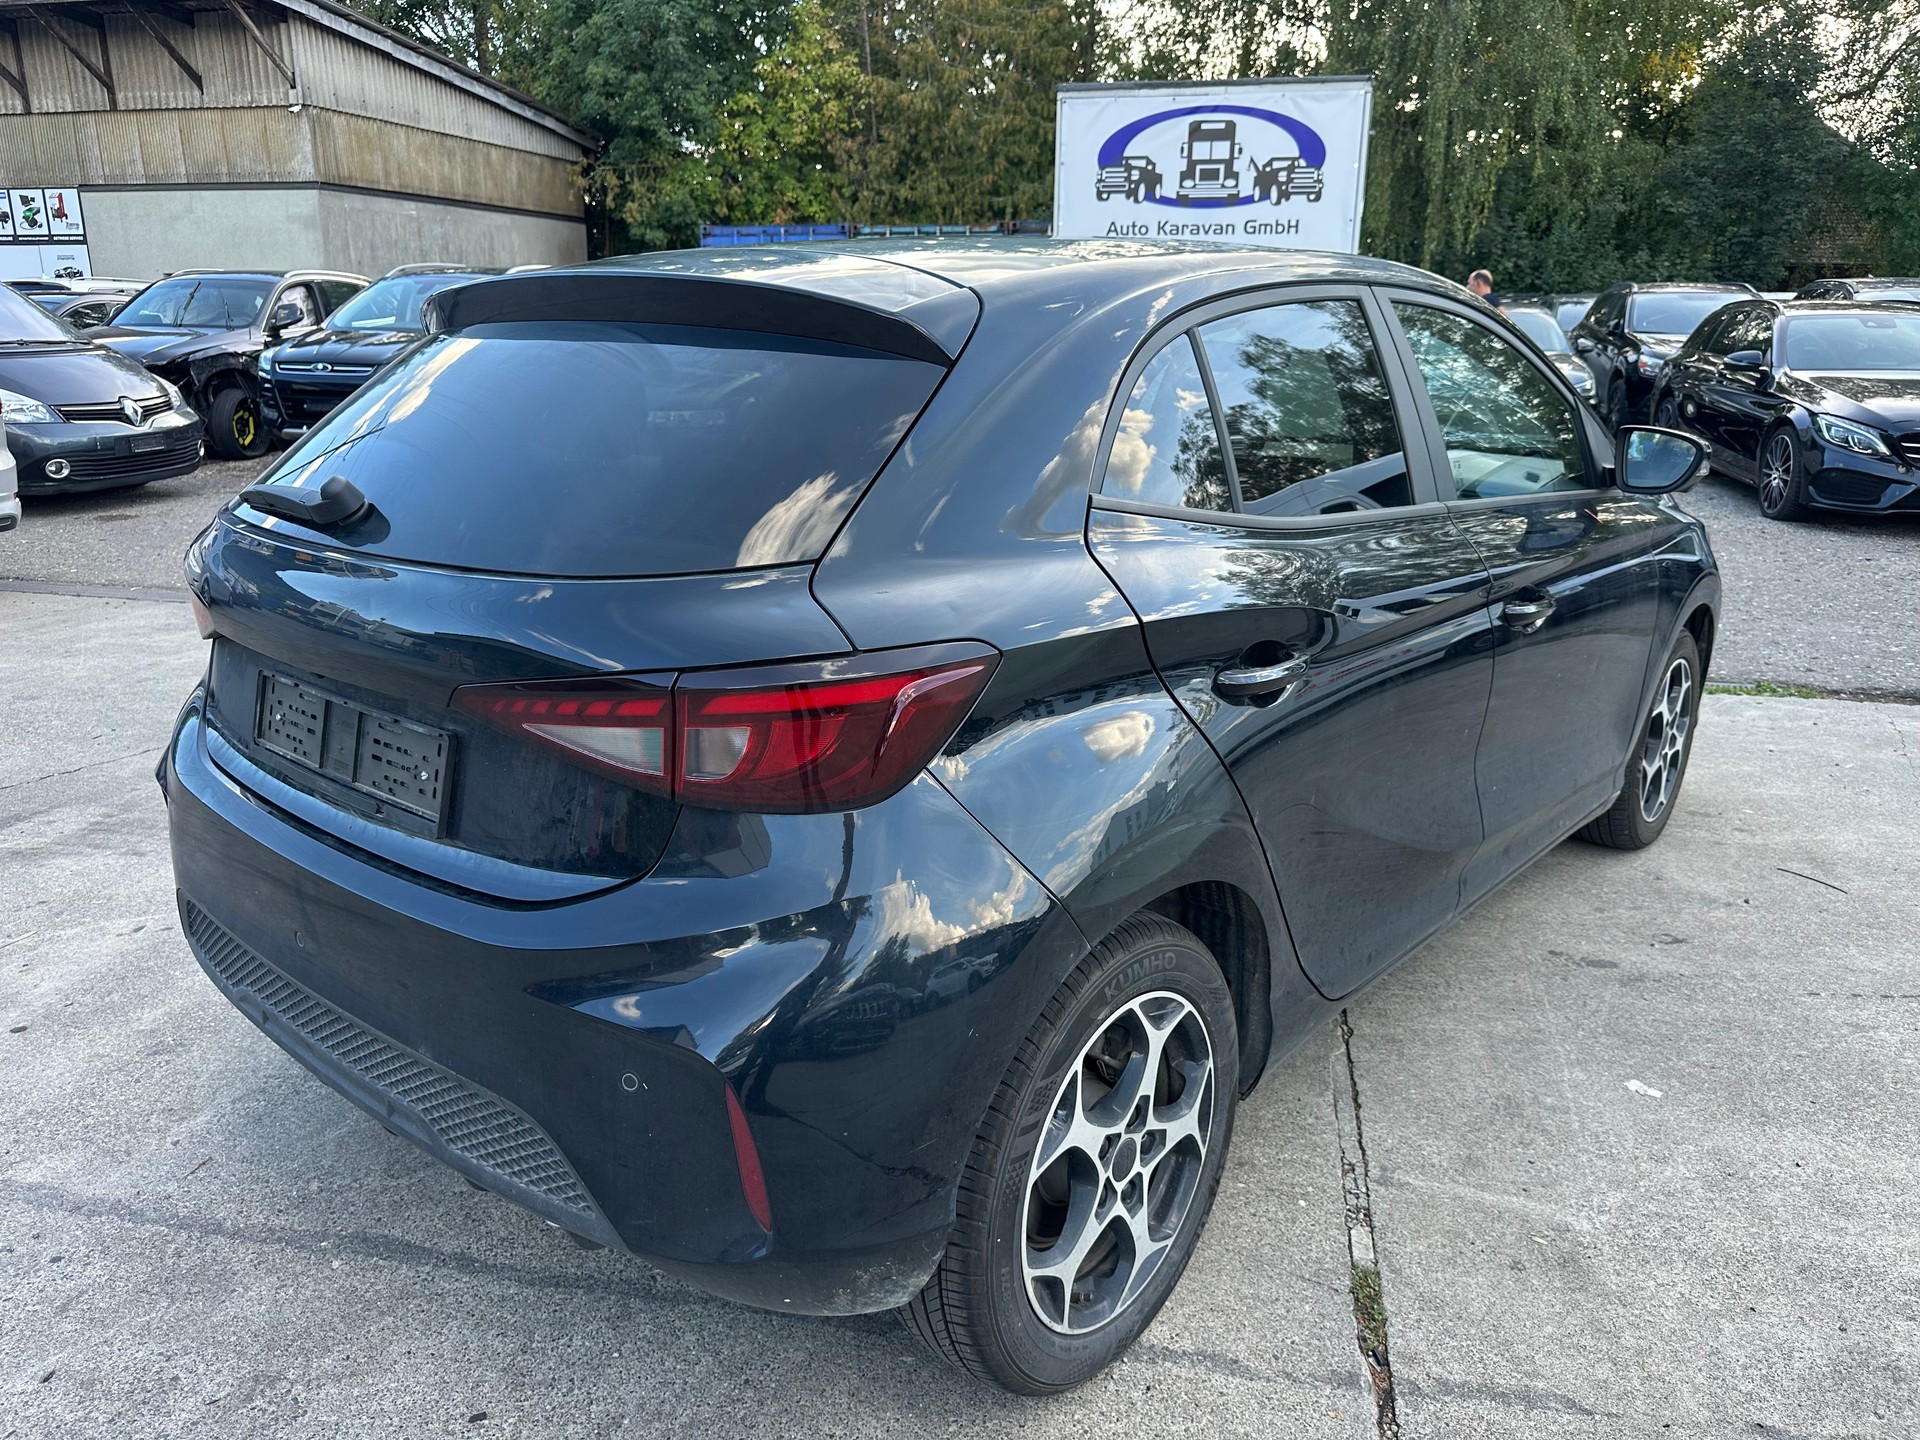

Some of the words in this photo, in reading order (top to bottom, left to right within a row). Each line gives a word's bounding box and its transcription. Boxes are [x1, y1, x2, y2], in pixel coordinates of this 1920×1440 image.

[1106, 221, 1149, 237] Auto
[1156, 220, 1236, 236] Karavan
[1243, 219, 1300, 235] GmbH
[1104, 951, 1177, 1003] KUMHO
